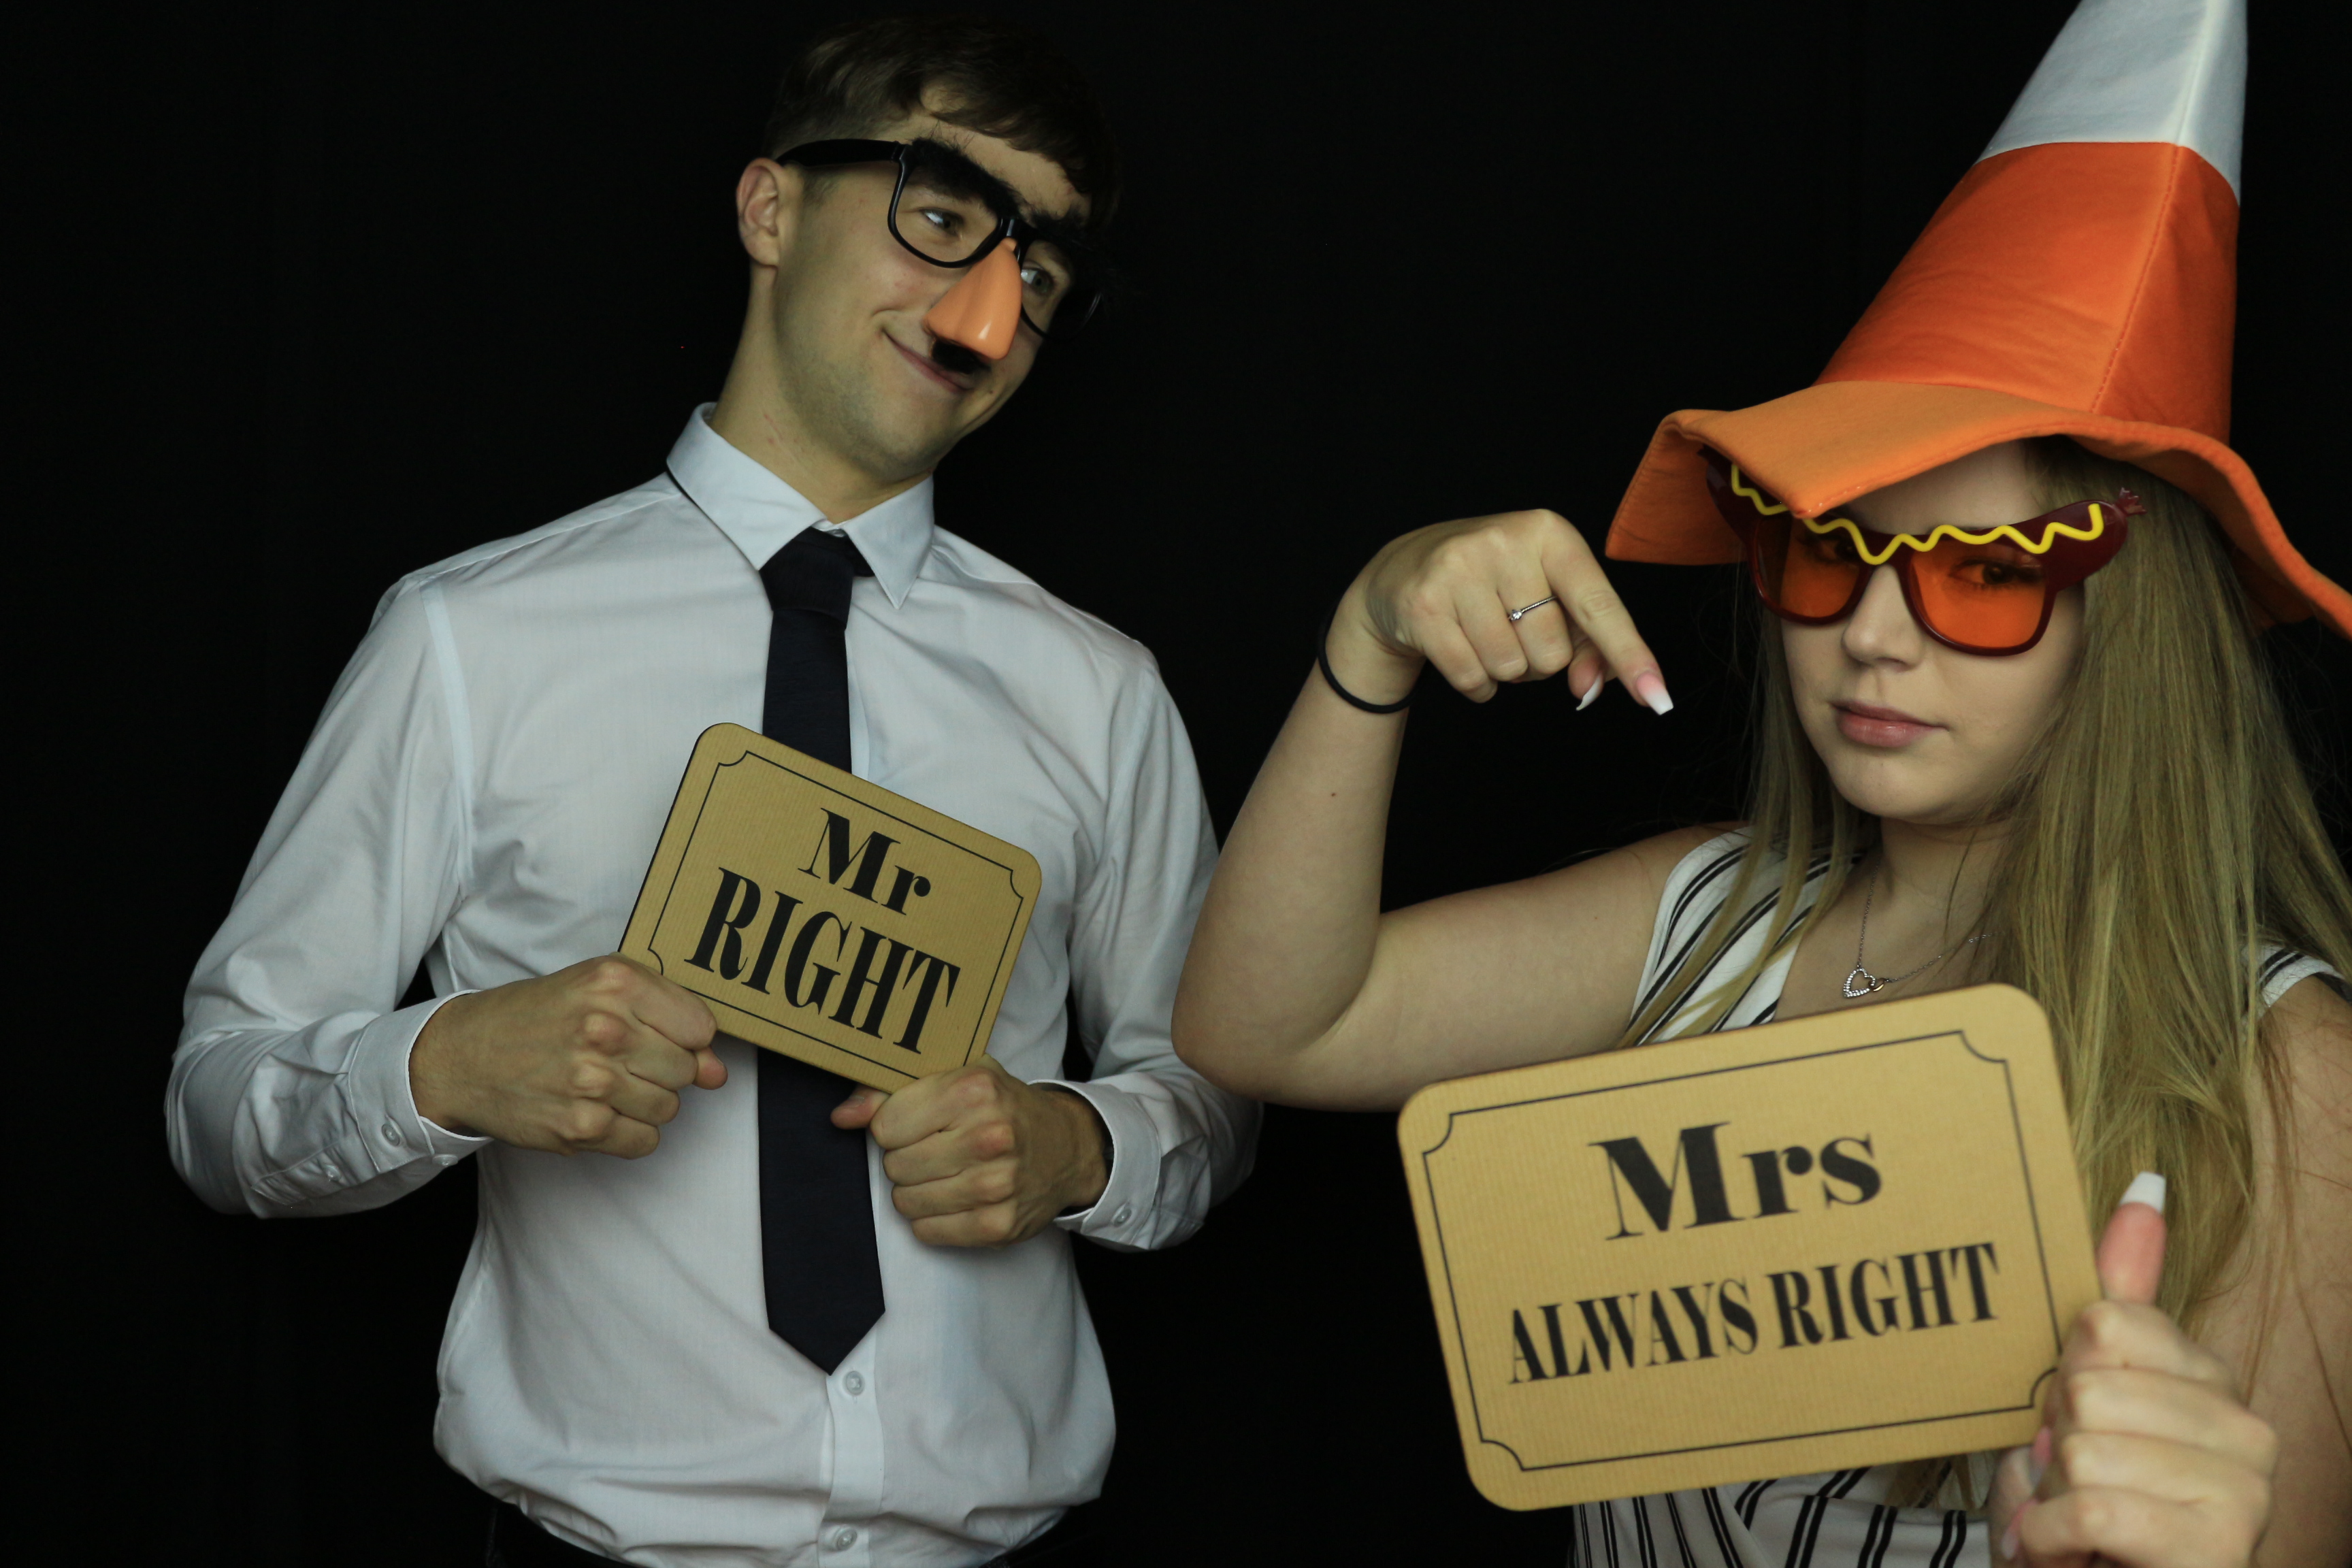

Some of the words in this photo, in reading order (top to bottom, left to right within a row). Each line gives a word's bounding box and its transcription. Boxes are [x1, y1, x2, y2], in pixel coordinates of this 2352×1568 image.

[798, 808, 931, 915] Mr
[684, 867, 960, 1054] RIGHT
[1587, 1122, 1882, 1240] Mrs
[1509, 1278, 1759, 1384] ALWAYS
[1766, 1242, 1999, 1350] RIGHT
